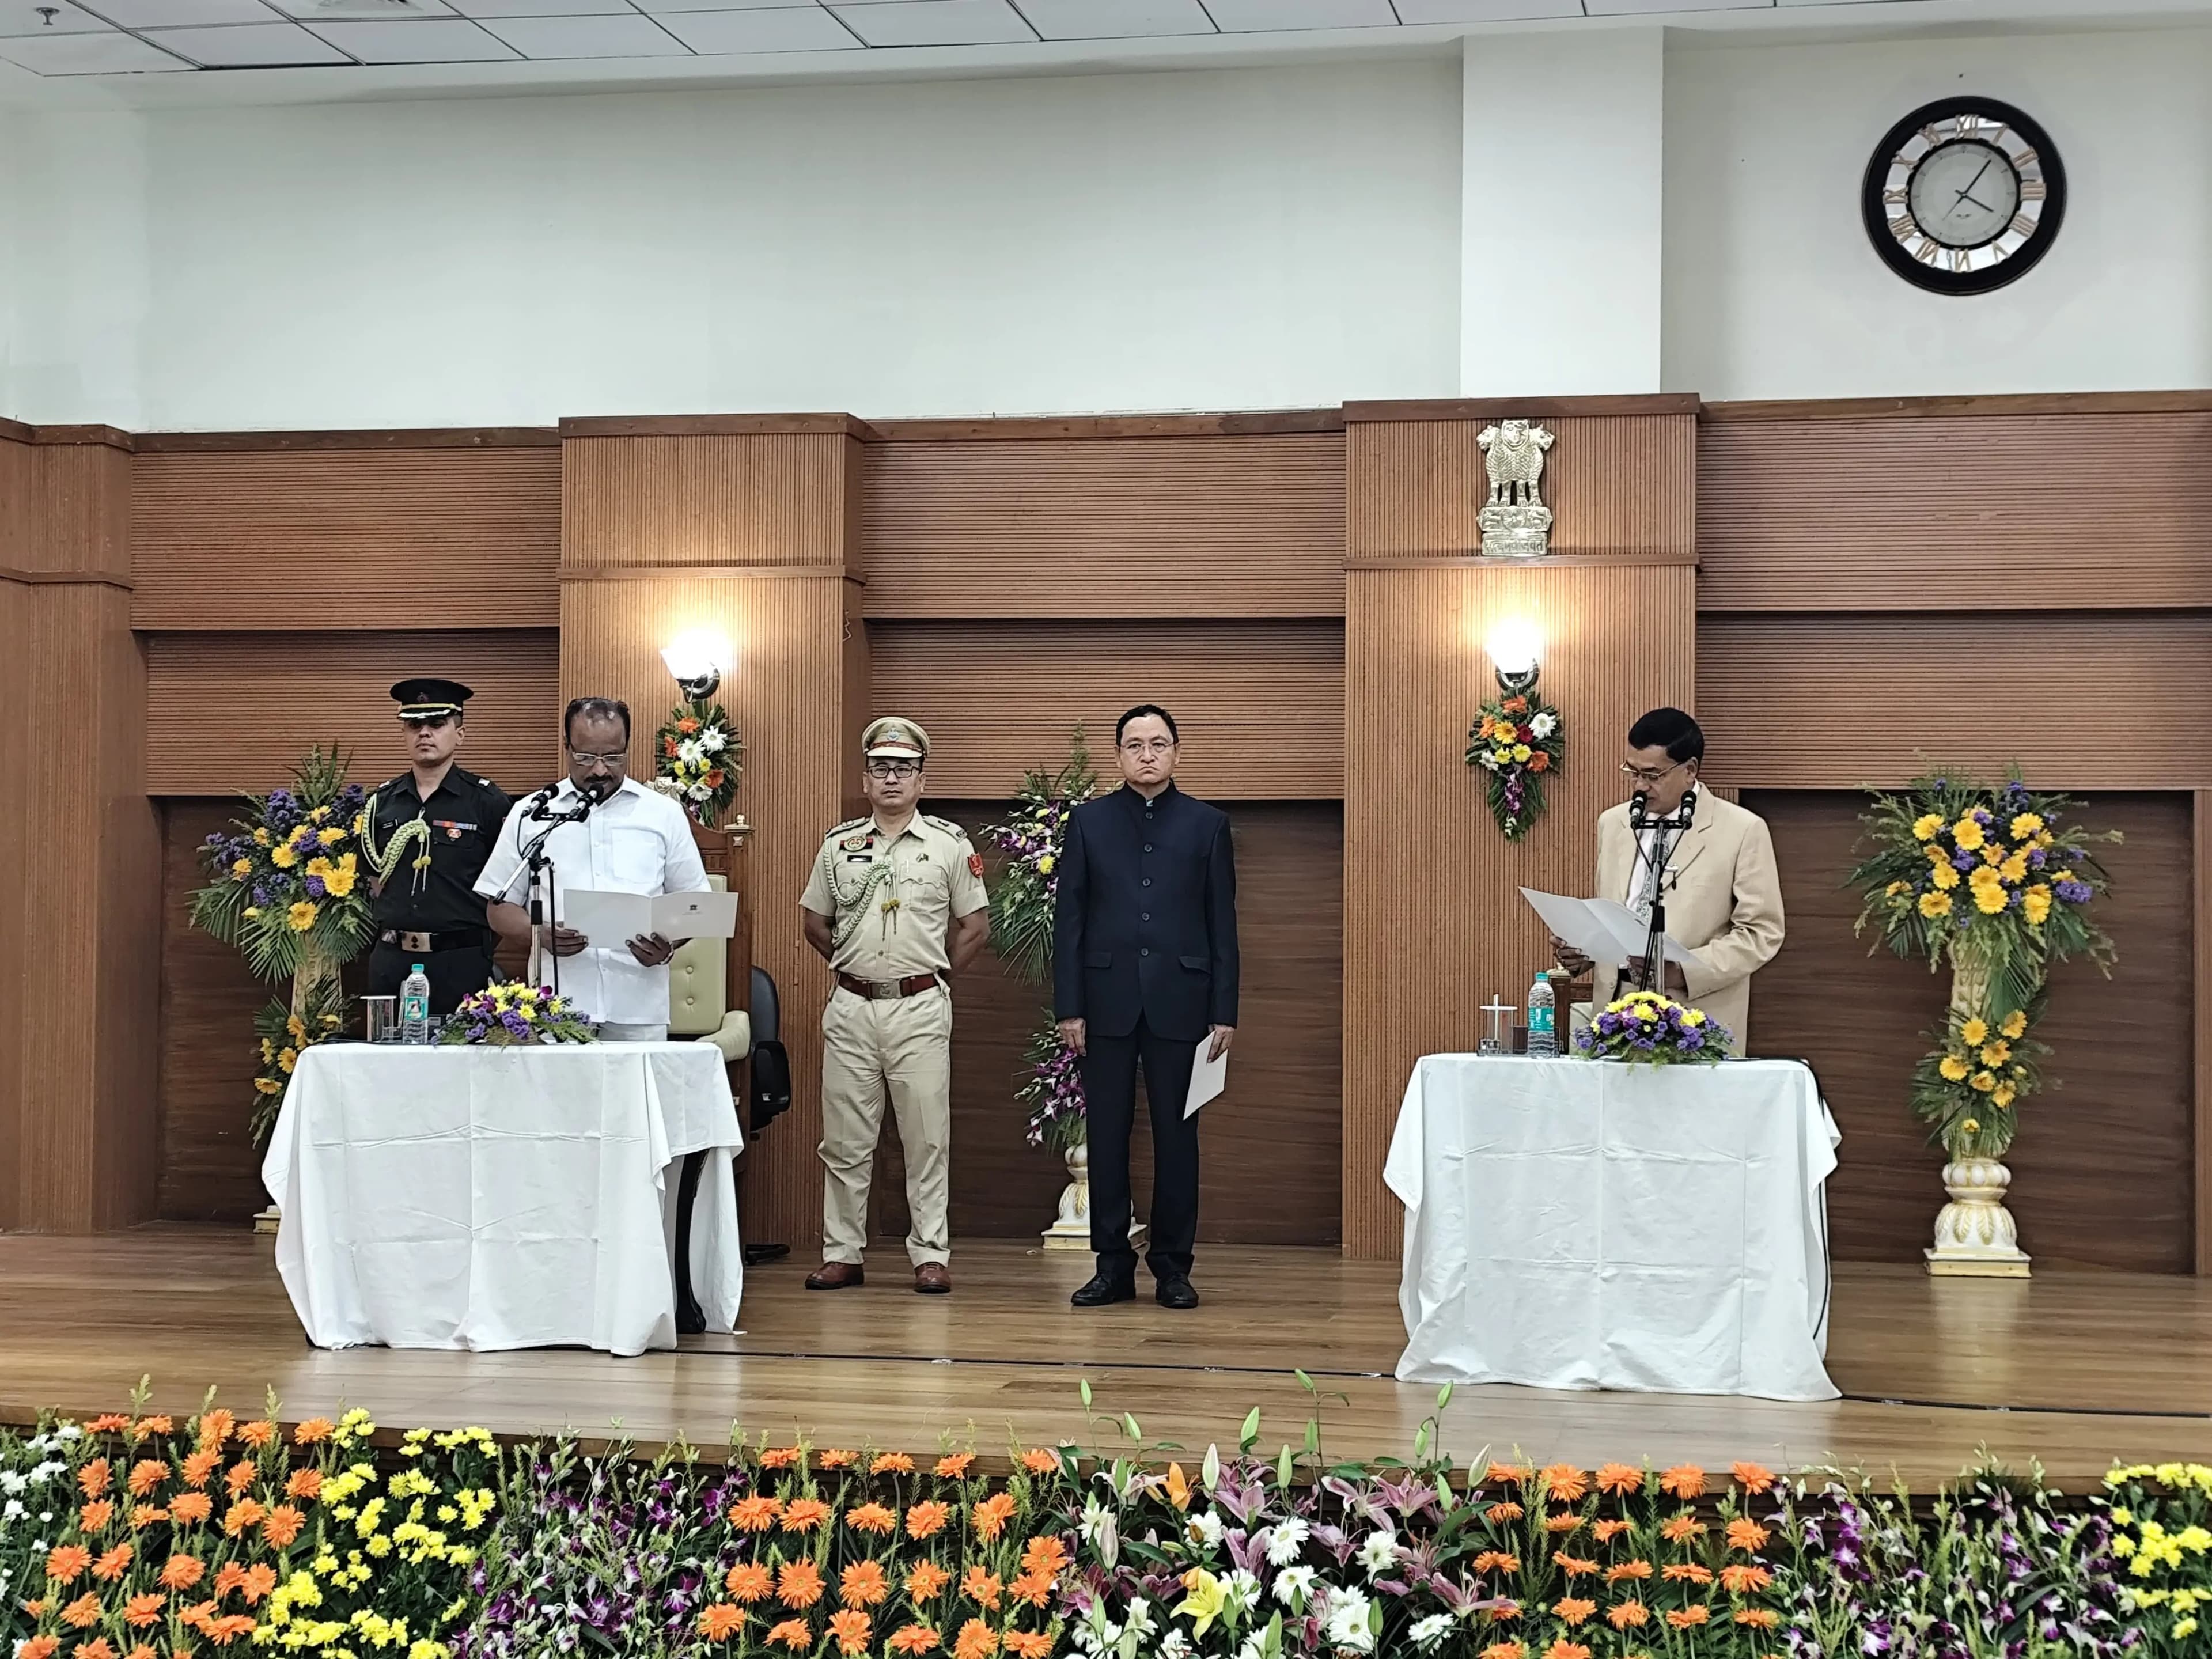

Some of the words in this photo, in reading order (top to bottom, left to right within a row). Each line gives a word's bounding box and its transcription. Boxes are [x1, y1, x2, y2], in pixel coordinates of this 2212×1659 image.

[1955, 114, 1979, 139] XII
[1990, 122, 2010, 147] I
[1891, 150, 1919, 173] X
[2012, 145, 2040, 171] II
[2020, 183, 2047, 202] III
[1952, 248, 1974, 274] VI
[1991, 240, 2012, 266] V
